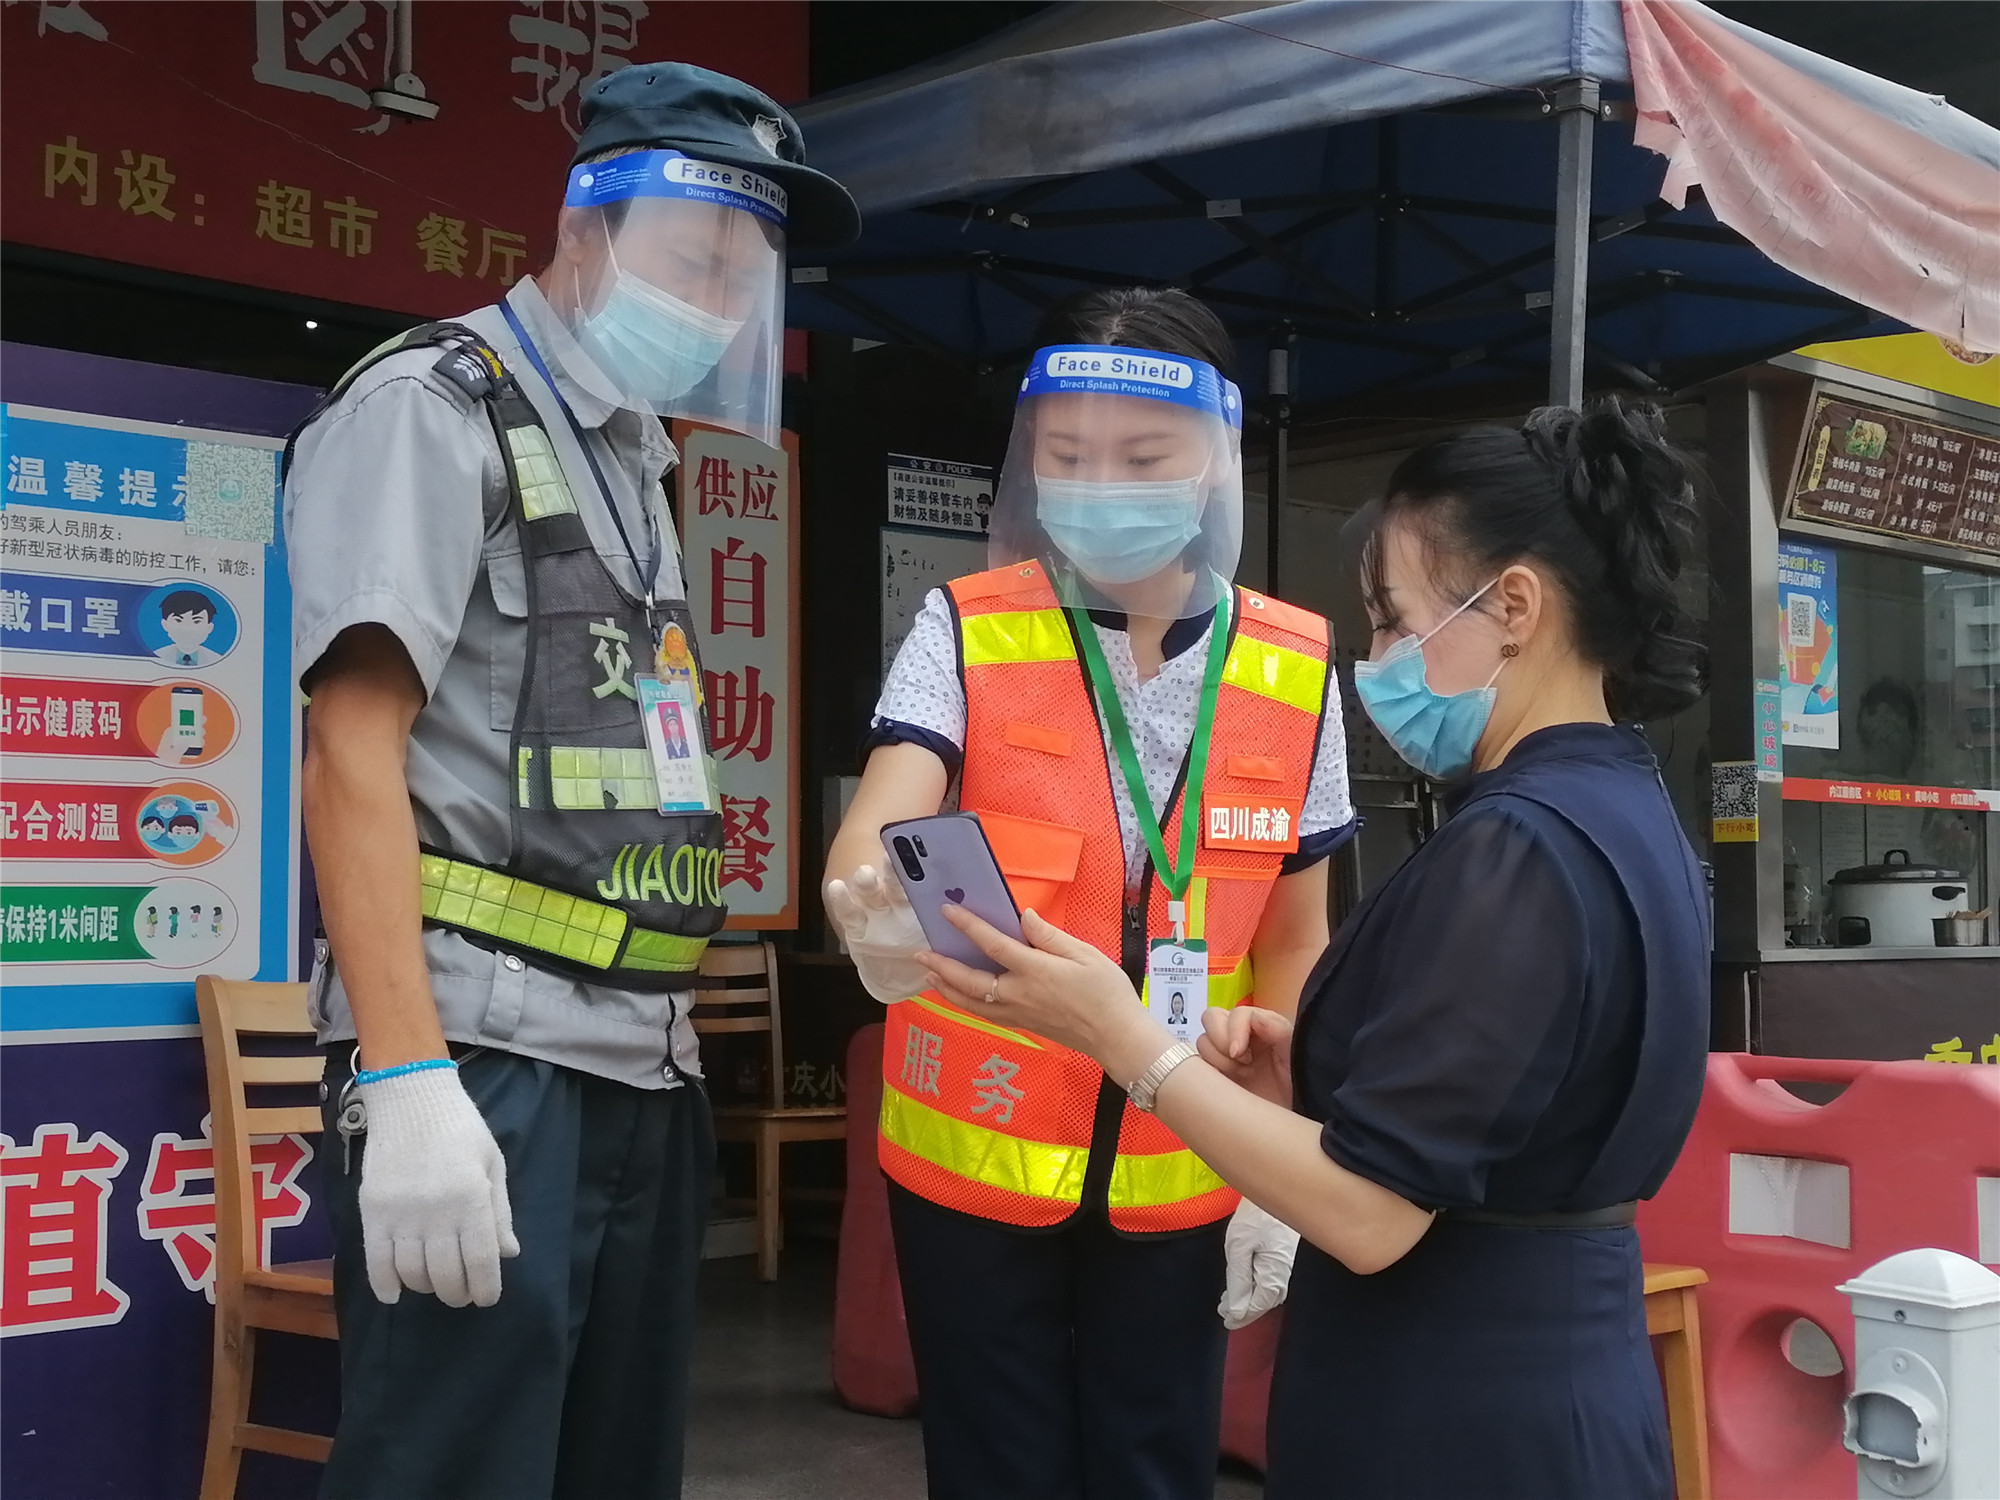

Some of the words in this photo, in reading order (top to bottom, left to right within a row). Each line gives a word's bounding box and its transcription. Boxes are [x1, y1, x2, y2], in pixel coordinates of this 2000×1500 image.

[681, 163, 733, 185] Face
[741, 175, 787, 210] Shield
[685, 187, 716, 202] Direct
[718, 192, 749, 210] Splash
[255, 180, 379, 259] 超市
[415, 211, 527, 287] 餐厅
[1058, 356, 1101, 372] Face
[1111, 358, 1181, 382] Shield
[1060, 379, 1085, 390] Direct
[1087, 380, 1119, 392] Splash
[1121, 383, 1170, 398] Protection
[694, 454, 780, 522] 供应
[910, 460, 931, 471] 公安
[946, 464, 973, 476] POLICE
[894, 486, 973, 510] 请妥善保管车内
[894, 505, 974, 527] 财物及随身物品
[0, 589, 120, 638] 戴口罩
[589, 617, 637, 700] 交
[703, 536, 776, 893] 自助餐
[1761, 700, 1777, 770] 小心玻璃
[0, 800, 120, 841] 配合测温
[1210, 806, 1290, 842] 四川成渝
[1716, 822, 1756, 833] 下行小吃
[0, 904, 119, 943] 保持1米间距
[900, 1024, 1025, 1123] 服务
